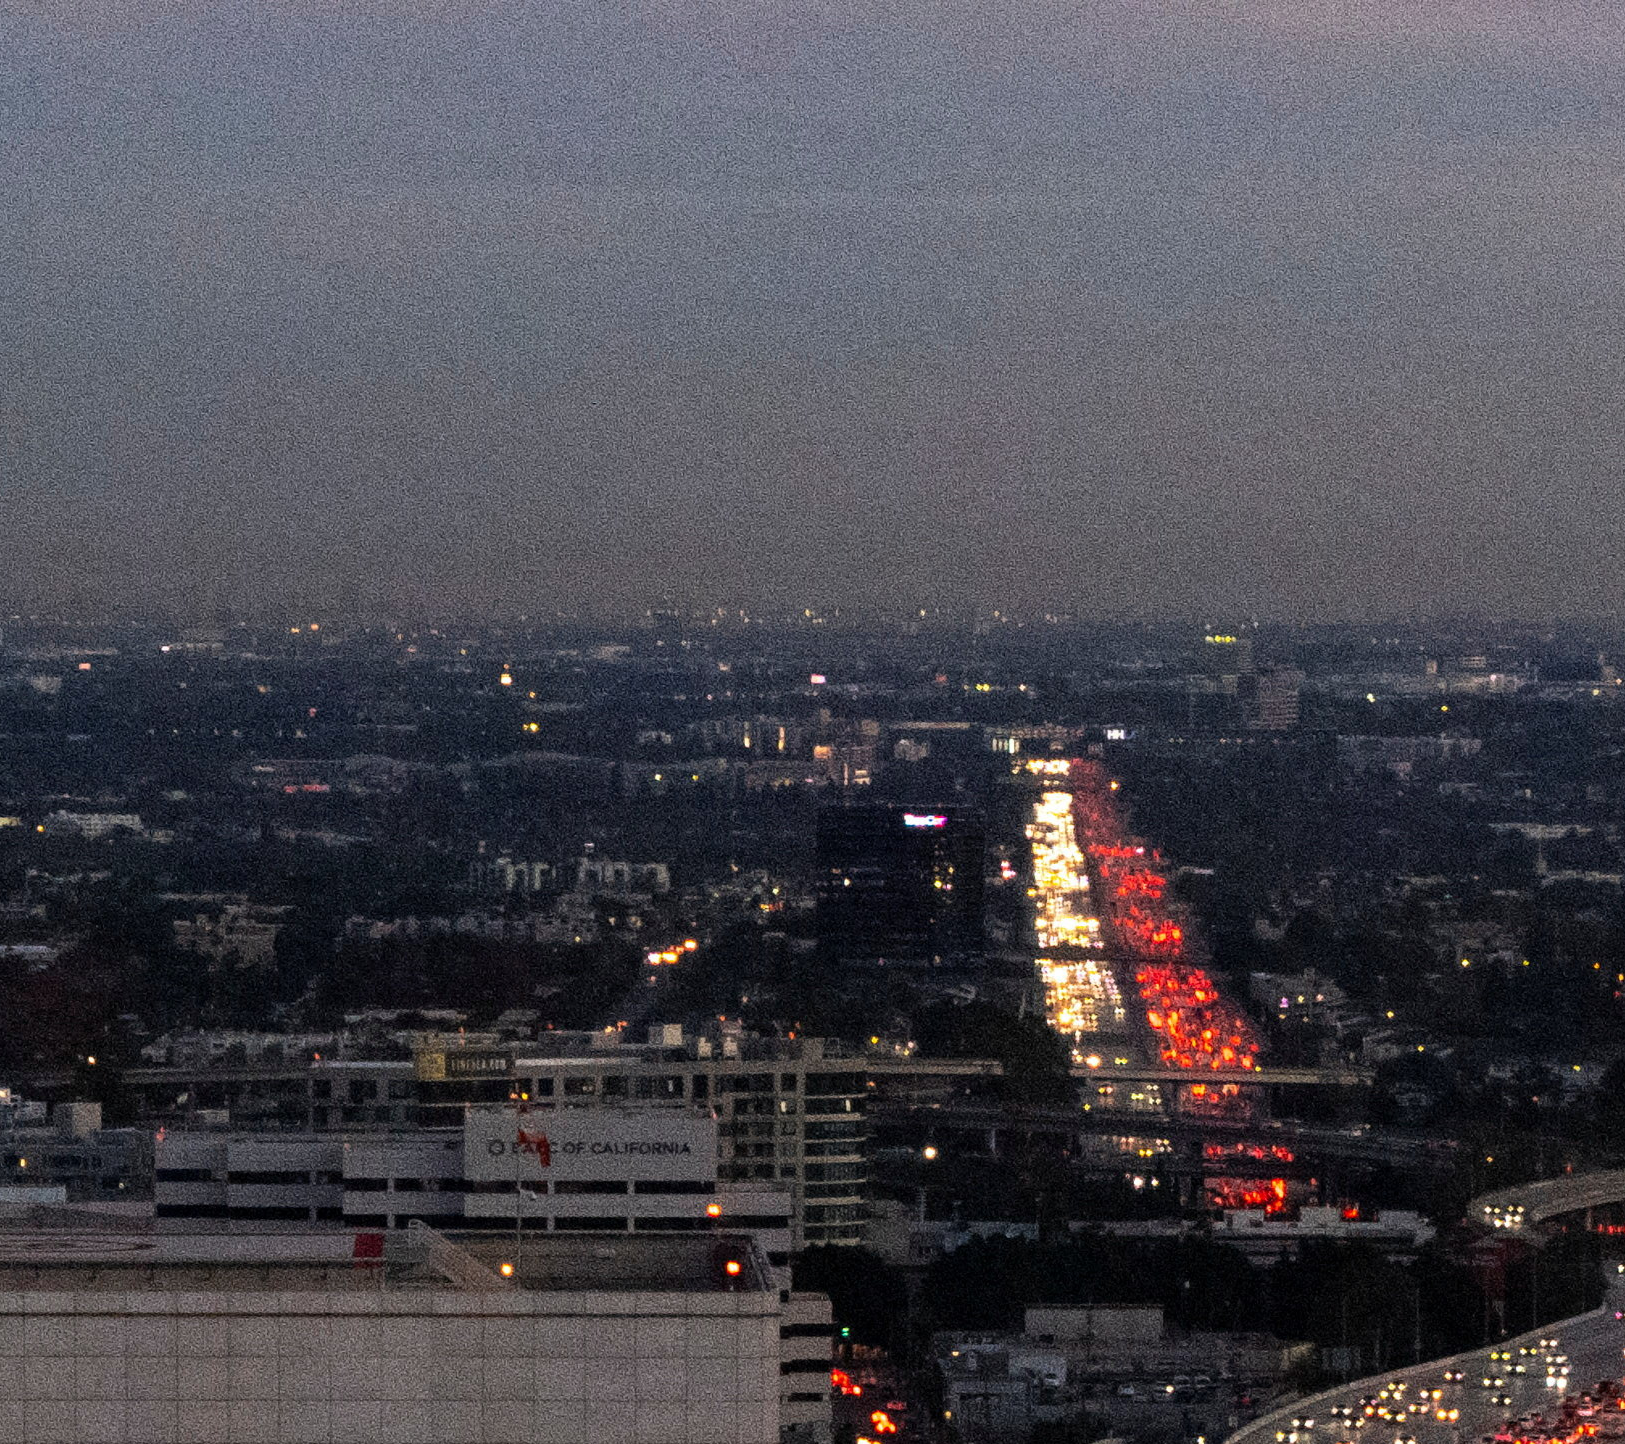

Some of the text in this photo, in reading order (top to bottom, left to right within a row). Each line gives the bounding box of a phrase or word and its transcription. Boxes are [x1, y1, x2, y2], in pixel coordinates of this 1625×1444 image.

[511, 1142, 691, 1155] BAC OF CALIFORNIA
